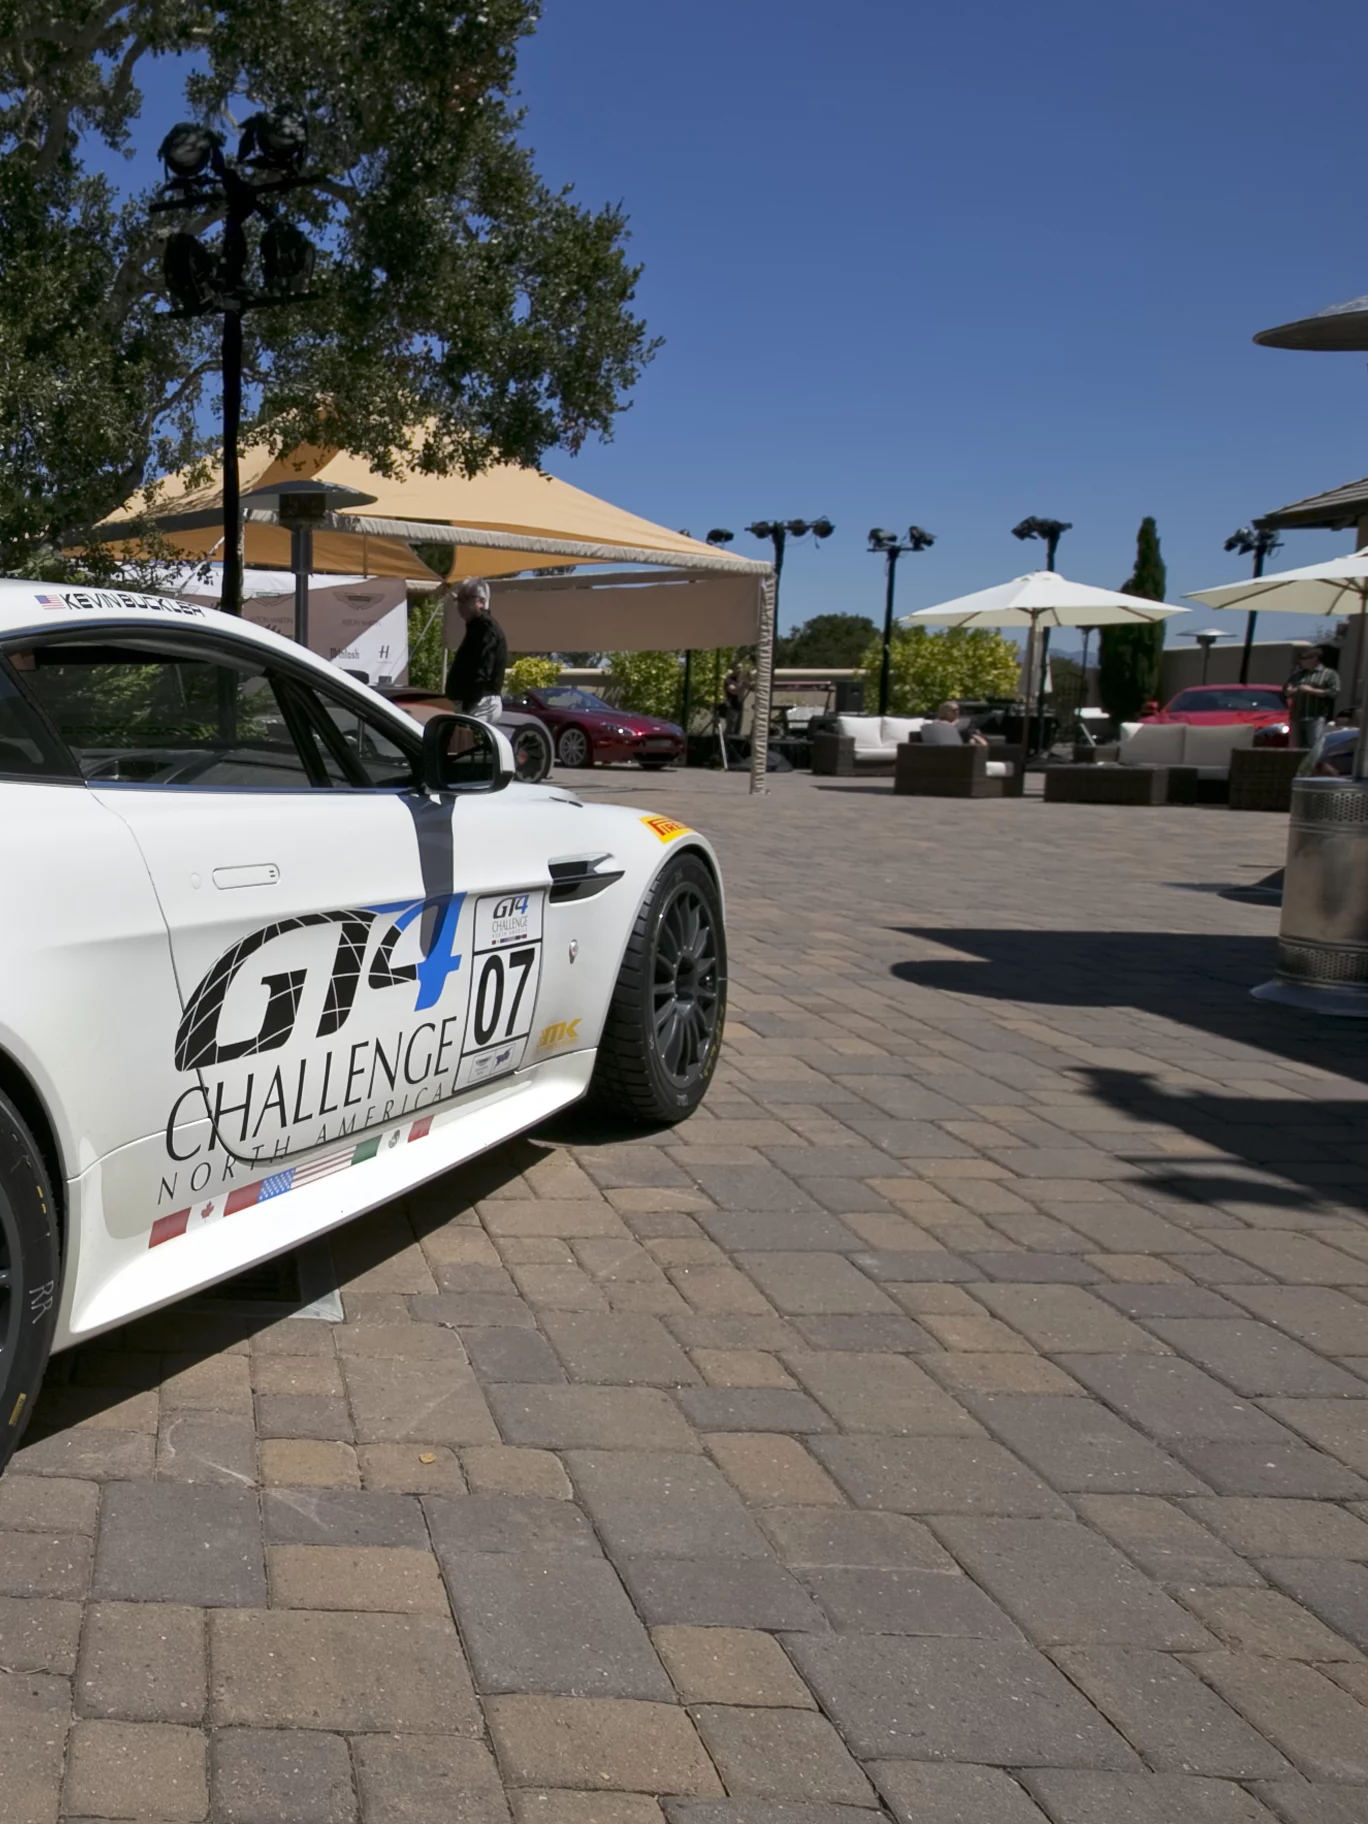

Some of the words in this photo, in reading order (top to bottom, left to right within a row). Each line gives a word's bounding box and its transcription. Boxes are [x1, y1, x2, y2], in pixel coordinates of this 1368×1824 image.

[59, 593, 122, 610] KEVIN
[118, 594, 206, 618] BUCKLER
[491, 915, 529, 933] CHALLENGE
[493, 895, 530, 919] GT4
[174, 891, 468, 1072] GT4
[474, 947, 535, 1046] 07
[165, 1016, 458, 1162] CHALLENGE
[157, 1135, 292, 1206] NORTH
[315, 1081, 445, 1146] AMERICA
[29, 1279, 54, 1324] RR
